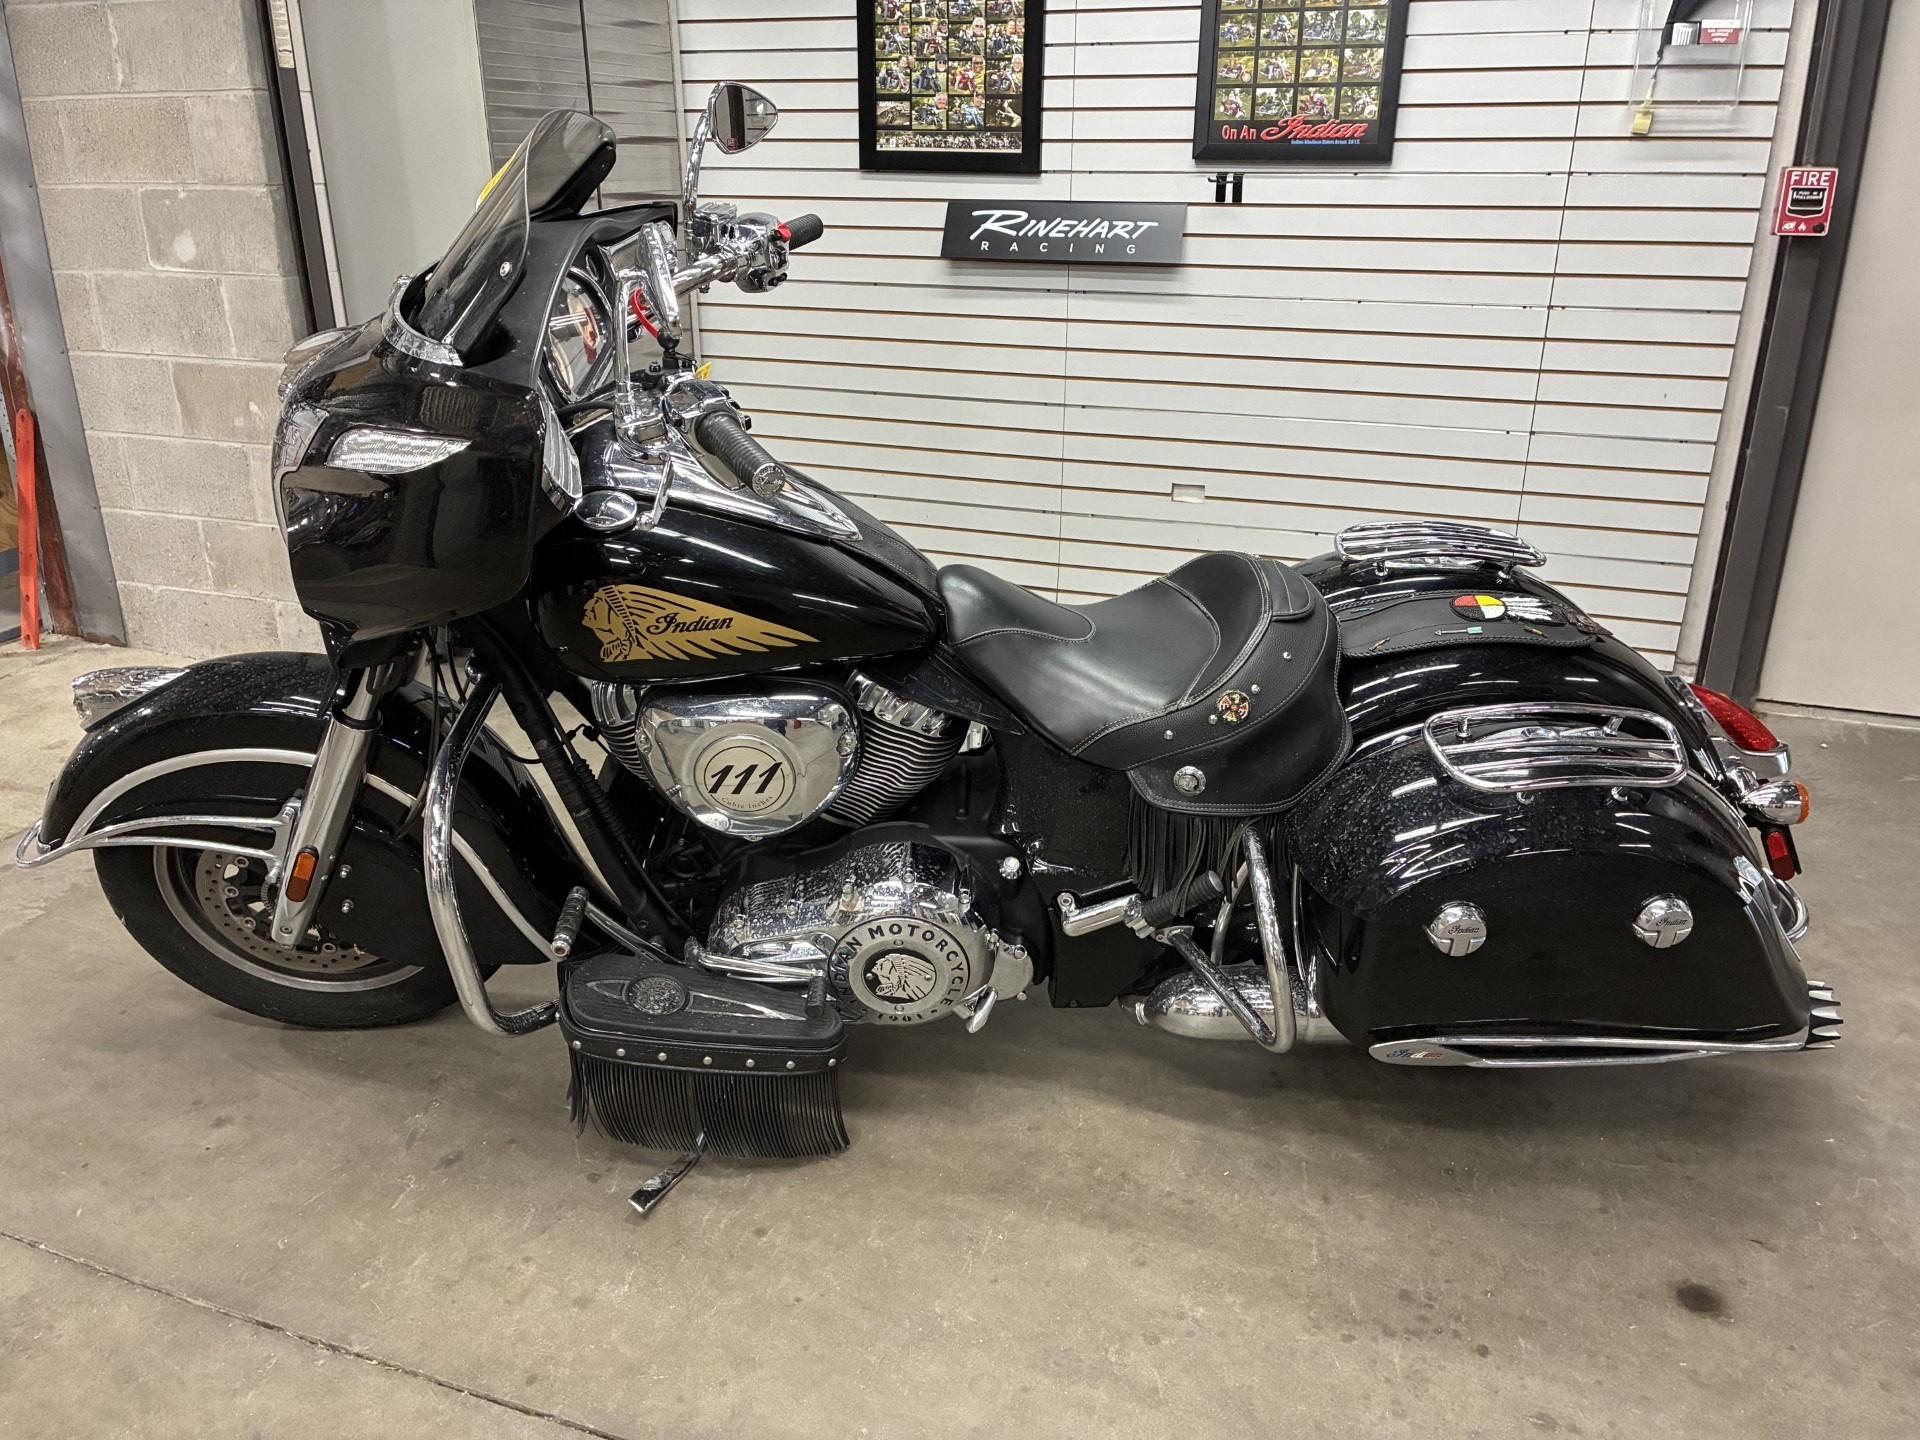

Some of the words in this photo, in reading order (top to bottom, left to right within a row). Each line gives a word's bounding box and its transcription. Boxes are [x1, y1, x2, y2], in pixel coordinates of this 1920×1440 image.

[1221, 125, 1237, 140] On
[1240, 125, 1256, 140] An
[1260, 113, 1369, 141] Indian
[1790, 171, 1832, 186] FIRE
[969, 209, 1159, 241] RINEHART
[981, 241, 1136, 254] RACING
[646, 612, 734, 635] Indian
[707, 761, 784, 795] 111
[721, 797, 745, 809] Cubic
[748, 795, 773, 809] Inches
[1655, 917, 1688, 926] Indian
[1447, 924, 1480, 935] Indian
[867, 923, 964, 1008] MOTORCYCLE
[876, 1012, 924, 1022] 1901
[1386, 1048, 1444, 1060] Indian
